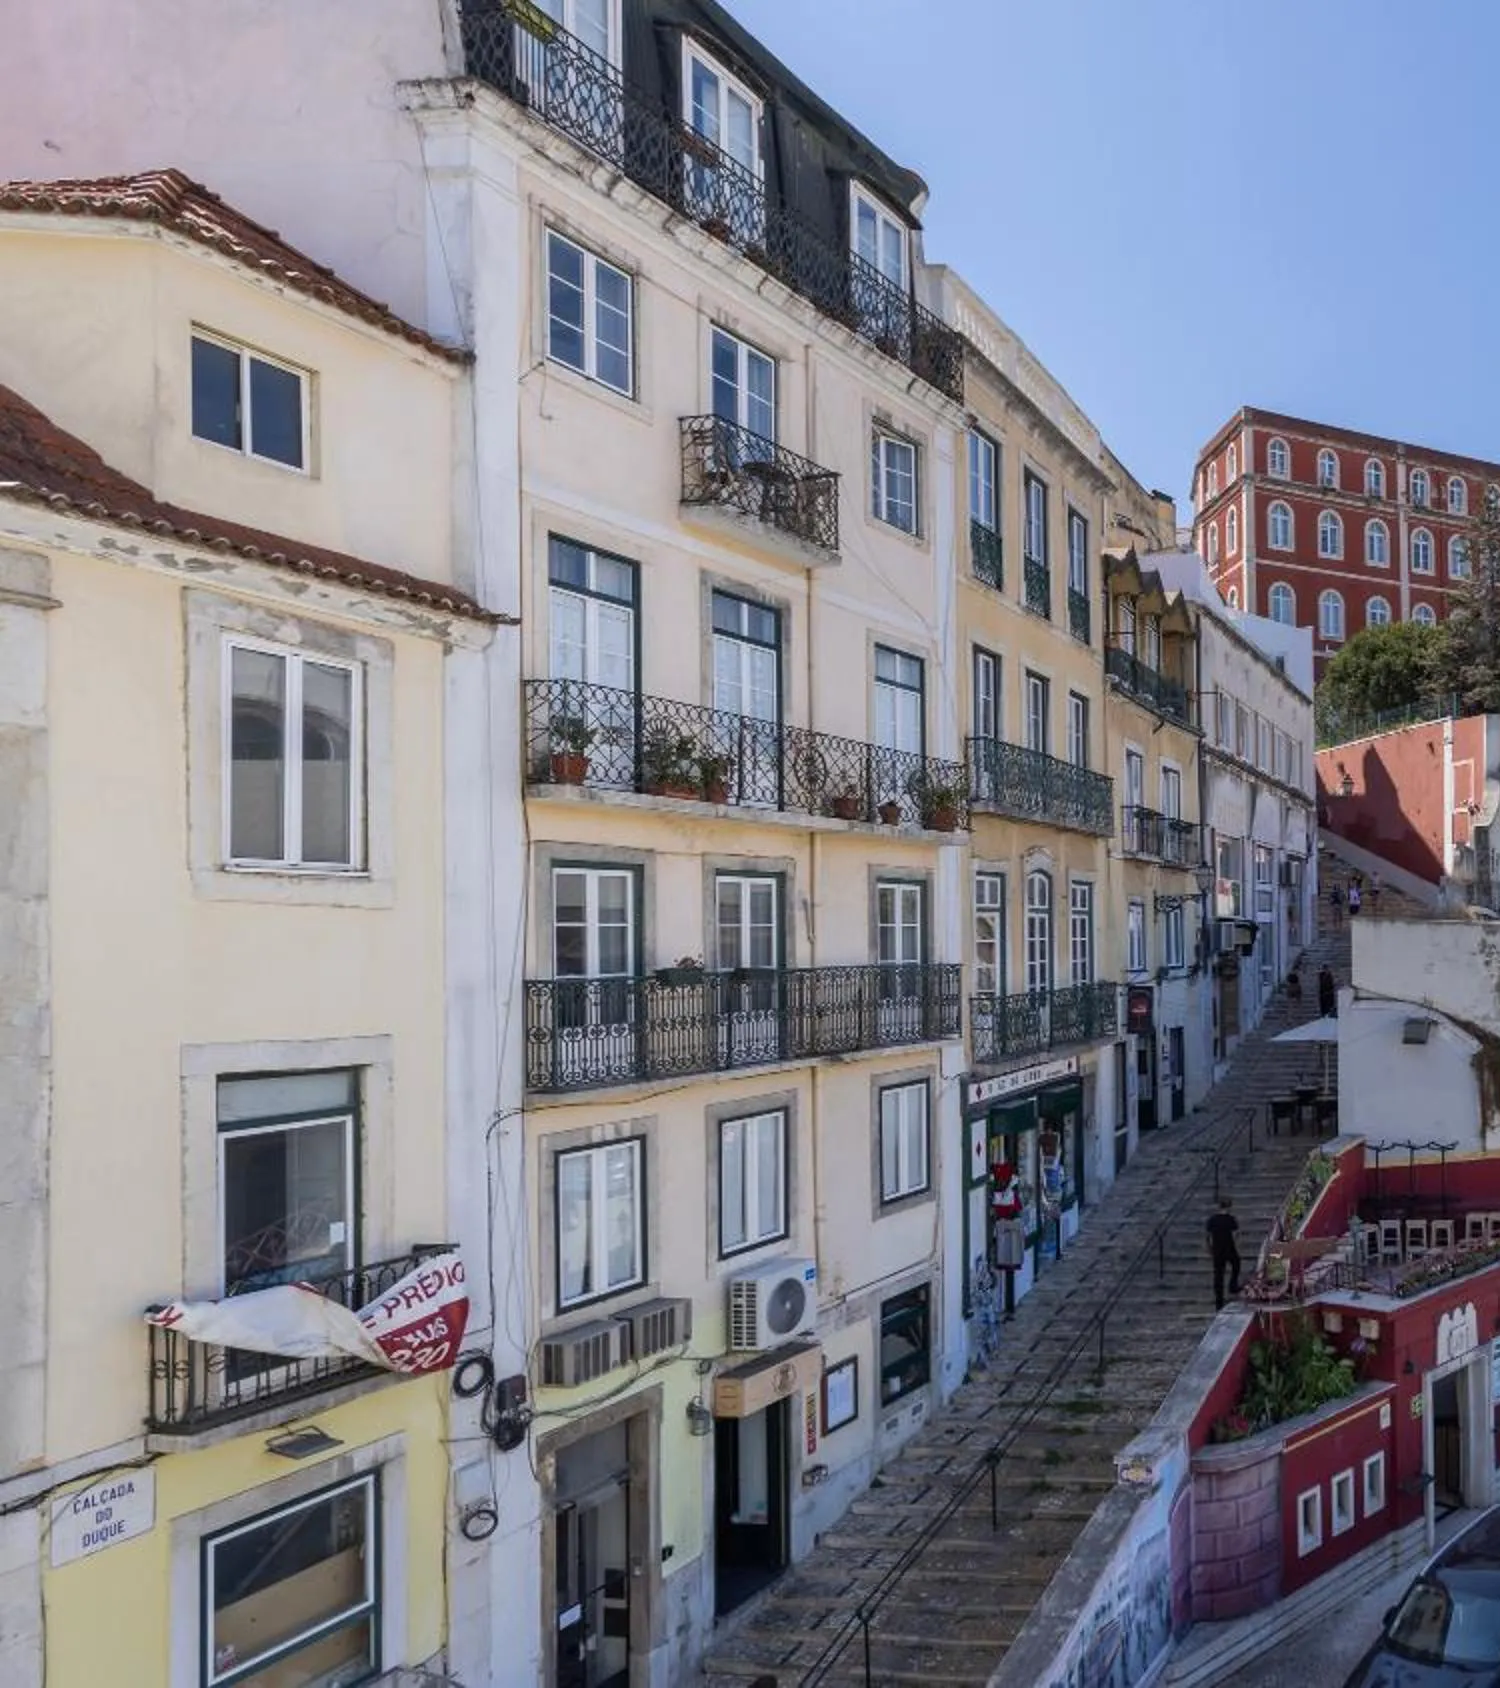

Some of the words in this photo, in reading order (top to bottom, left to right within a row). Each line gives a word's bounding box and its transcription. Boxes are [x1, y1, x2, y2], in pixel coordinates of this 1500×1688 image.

[73, 1481, 135, 1515] CALÇADA
[95, 1507, 113, 1525] DO
[82, 1519, 125, 1549] DUQUE
